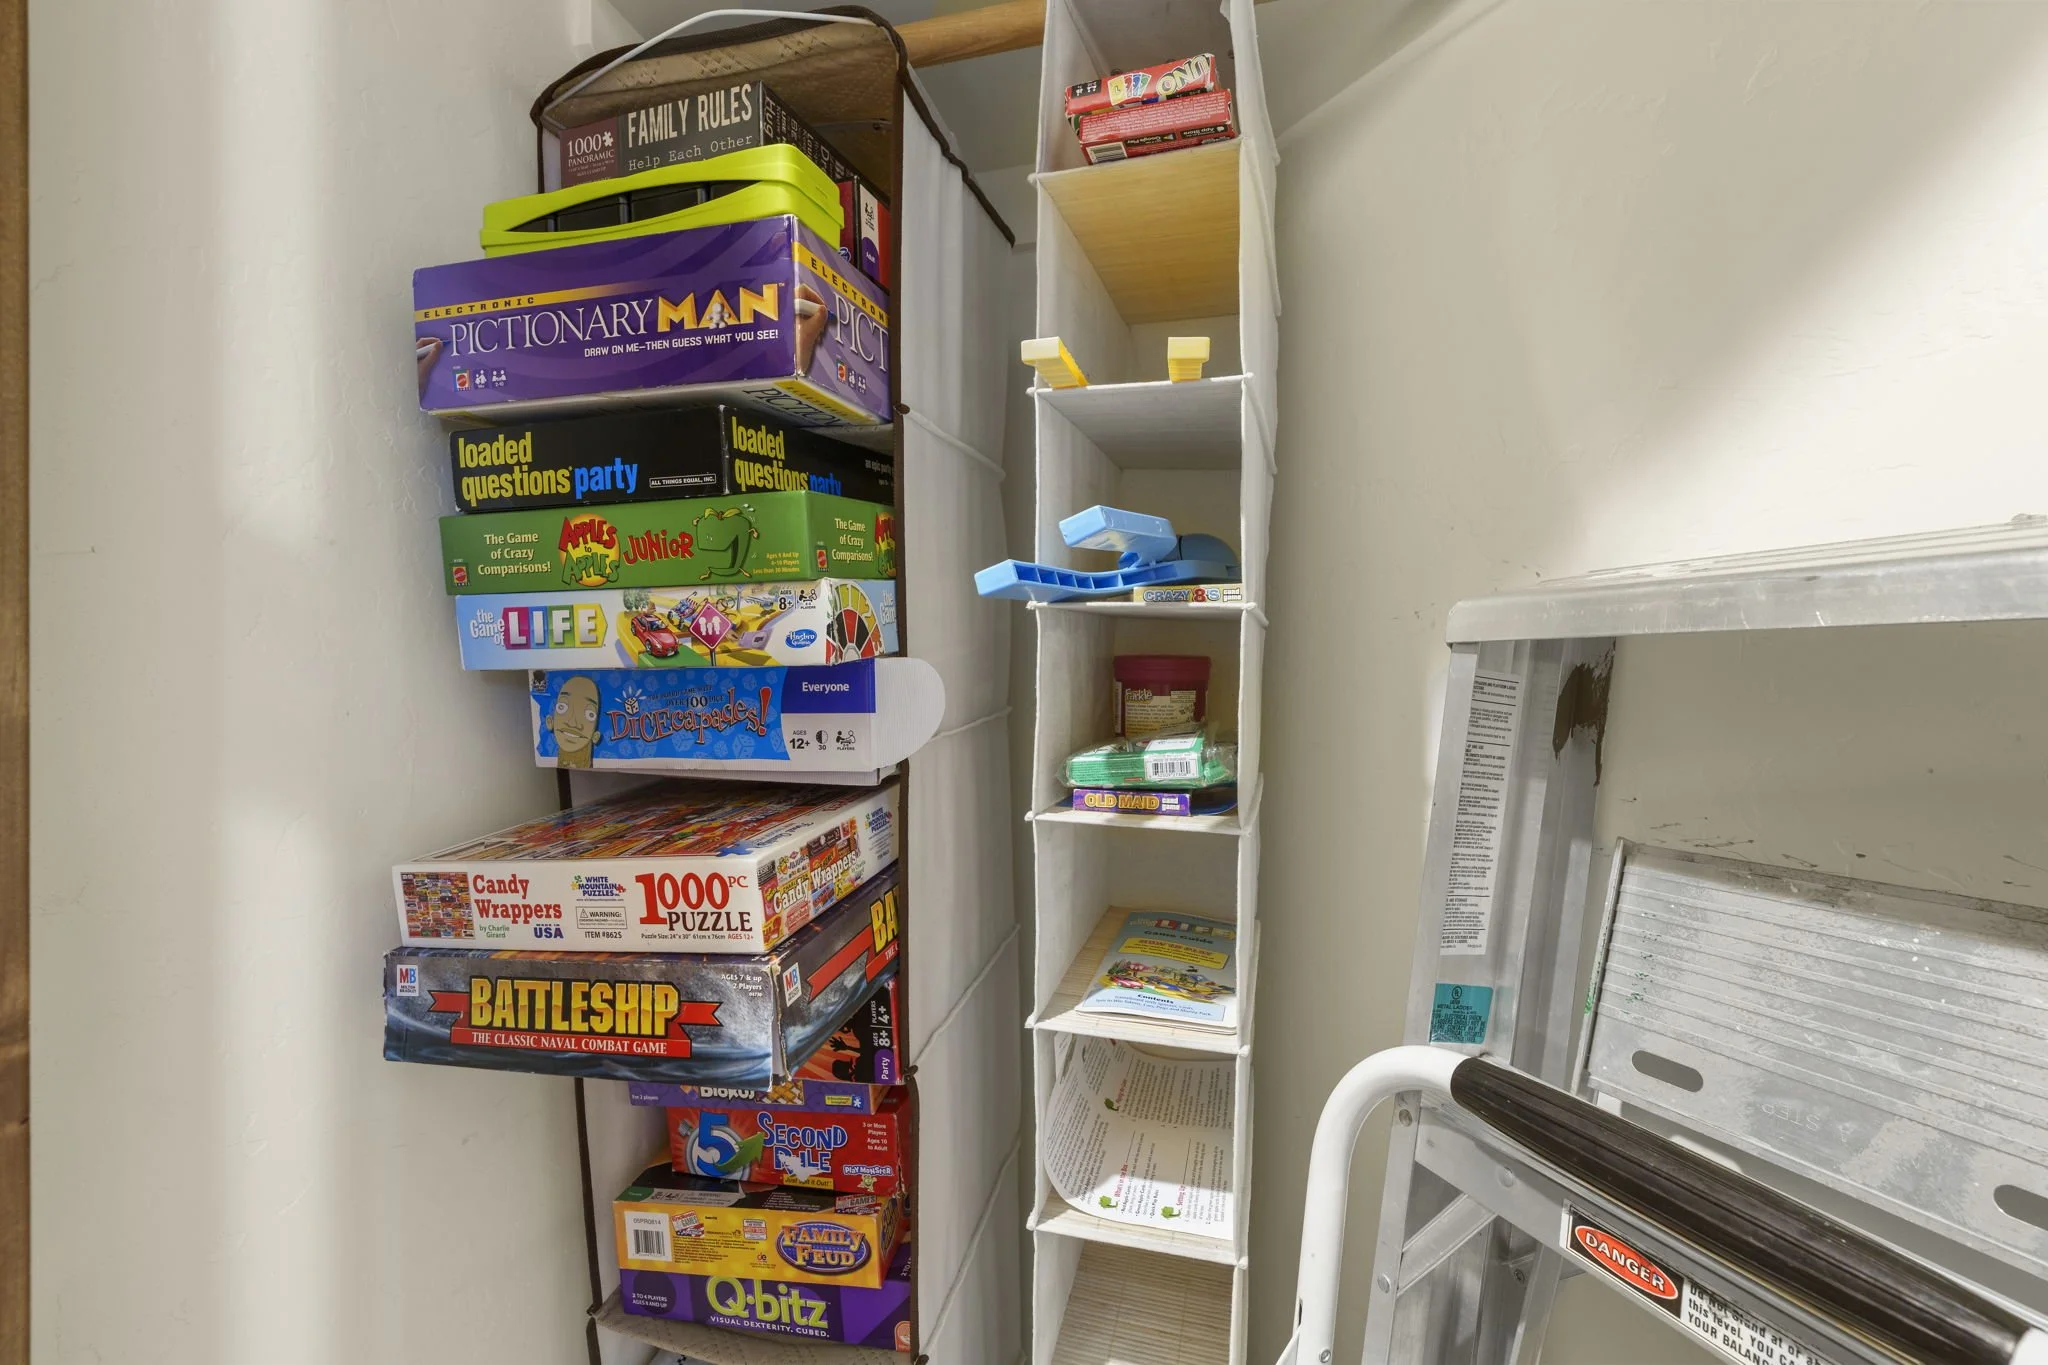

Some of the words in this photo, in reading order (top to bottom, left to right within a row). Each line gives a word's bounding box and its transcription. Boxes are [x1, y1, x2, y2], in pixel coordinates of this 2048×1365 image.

[1156, 53, 1210, 96] UNO
[628, 99, 689, 149] FAMILY
[698, 83, 752, 132] RULES
[568, 134, 602, 157] 1000
[628, 155, 660, 171] Help
[669, 146, 701, 162] Each
[710, 134, 752, 152] Other
[568, 149, 615, 167] PANORAMIC
[424, 295, 535, 319] ELECTRONIC
[449, 299, 653, 357] PICTIONARY
[658, 283, 779, 333] MAN
[585, 347, 609, 358] DRAW
[612, 344, 624, 354] ON
[672, 337, 702, 348] GUESS
[704, 334, 732, 345] WHAT
[734, 332, 754, 342] YOU
[756, 329, 779, 341] SEE!
[732, 415, 786, 461] loaded
[458, 431, 533, 469] loaded
[462, 464, 571, 507] questions
[574, 457, 638, 500] party
[703, 475, 715, 483] INC.
[735, 457, 809, 492] questions
[835, 517, 847, 530] The
[847, 520, 866, 533] Game
[484, 534, 506, 546] The
[507, 532, 539, 545] Game
[584, 545, 592, 553] to
[839, 534, 847, 546] of
[847, 535, 864, 549] Crazy
[491, 549, 502, 560] of
[503, 548, 534, 561] Crazy
[832, 549, 874, 563] Comparisons!
[478, 560, 552, 577] Comparisons!
[779, 597, 793, 611] 8+
[1143, 589, 1191, 602] CRAZY
[477, 608, 494, 623] the
[470, 618, 505, 640] Game
[494, 632, 505, 647] of
[508, 608, 597, 646] LIFE
[790, 631, 815, 642] Hasbro
[802, 682, 850, 695] Everyone
[1125, 688, 1153, 701] Farkle
[789, 738, 811, 750] 12+
[1084, 793, 1117, 808] OLD
[1118, 794, 1160, 810] MAID
[473, 873, 530, 900] Candy
[773, 878, 810, 914] Candy
[811, 850, 858, 890] Wrappers
[635, 872, 730, 925] 1000
[727, 875, 749, 888] PC
[474, 899, 563, 925] Wrappers
[667, 911, 753, 932] PUZZLE
[479, 926, 487, 934] by
[488, 924, 510, 932] Charlie
[486, 931, 506, 939] Girard
[533, 926, 564, 939] USA
[585, 931, 601, 939] ITEM
[399, 968, 417, 984] MB
[738, 983, 762, 991] Players
[785, 971, 798, 992] MB
[470, 977, 680, 1037] BATTLESHIP
[1138, 994, 1174, 1004] Contents
[878, 1005, 890, 1024] 4+
[472, 1031, 491, 1044] THE
[494, 1033, 538, 1048] CLASSIC
[540, 1036, 577, 1050] NAVAL
[582, 1038, 630, 1053] COMBAT
[633, 1041, 668, 1055] GAME
[879, 1030, 891, 1047] 8+
[881, 1057, 891, 1080] Party
[757, 1110, 848, 1151] SECOND
[697, 1111, 737, 1177] 5
[782, 1225, 866, 1251] FAMILY
[795, 1244, 856, 1266] FEUD
[1584, 1230, 1665, 1292] DANGER
[710, 1316, 741, 1326] VISUAL
[743, 1320, 794, 1333] DEXTERITY.
[795, 1327, 830, 1338] CUBED.
[1687, 1312, 1718, 1339] YOUR
[1688, 1298, 1709, 1318] this
[1712, 1312, 1744, 1340] level.
[1750, 1335, 1774, 1358] YOU
[1771, 1334, 1783, 1348] at
[1787, 1345, 1801, 1358] or
